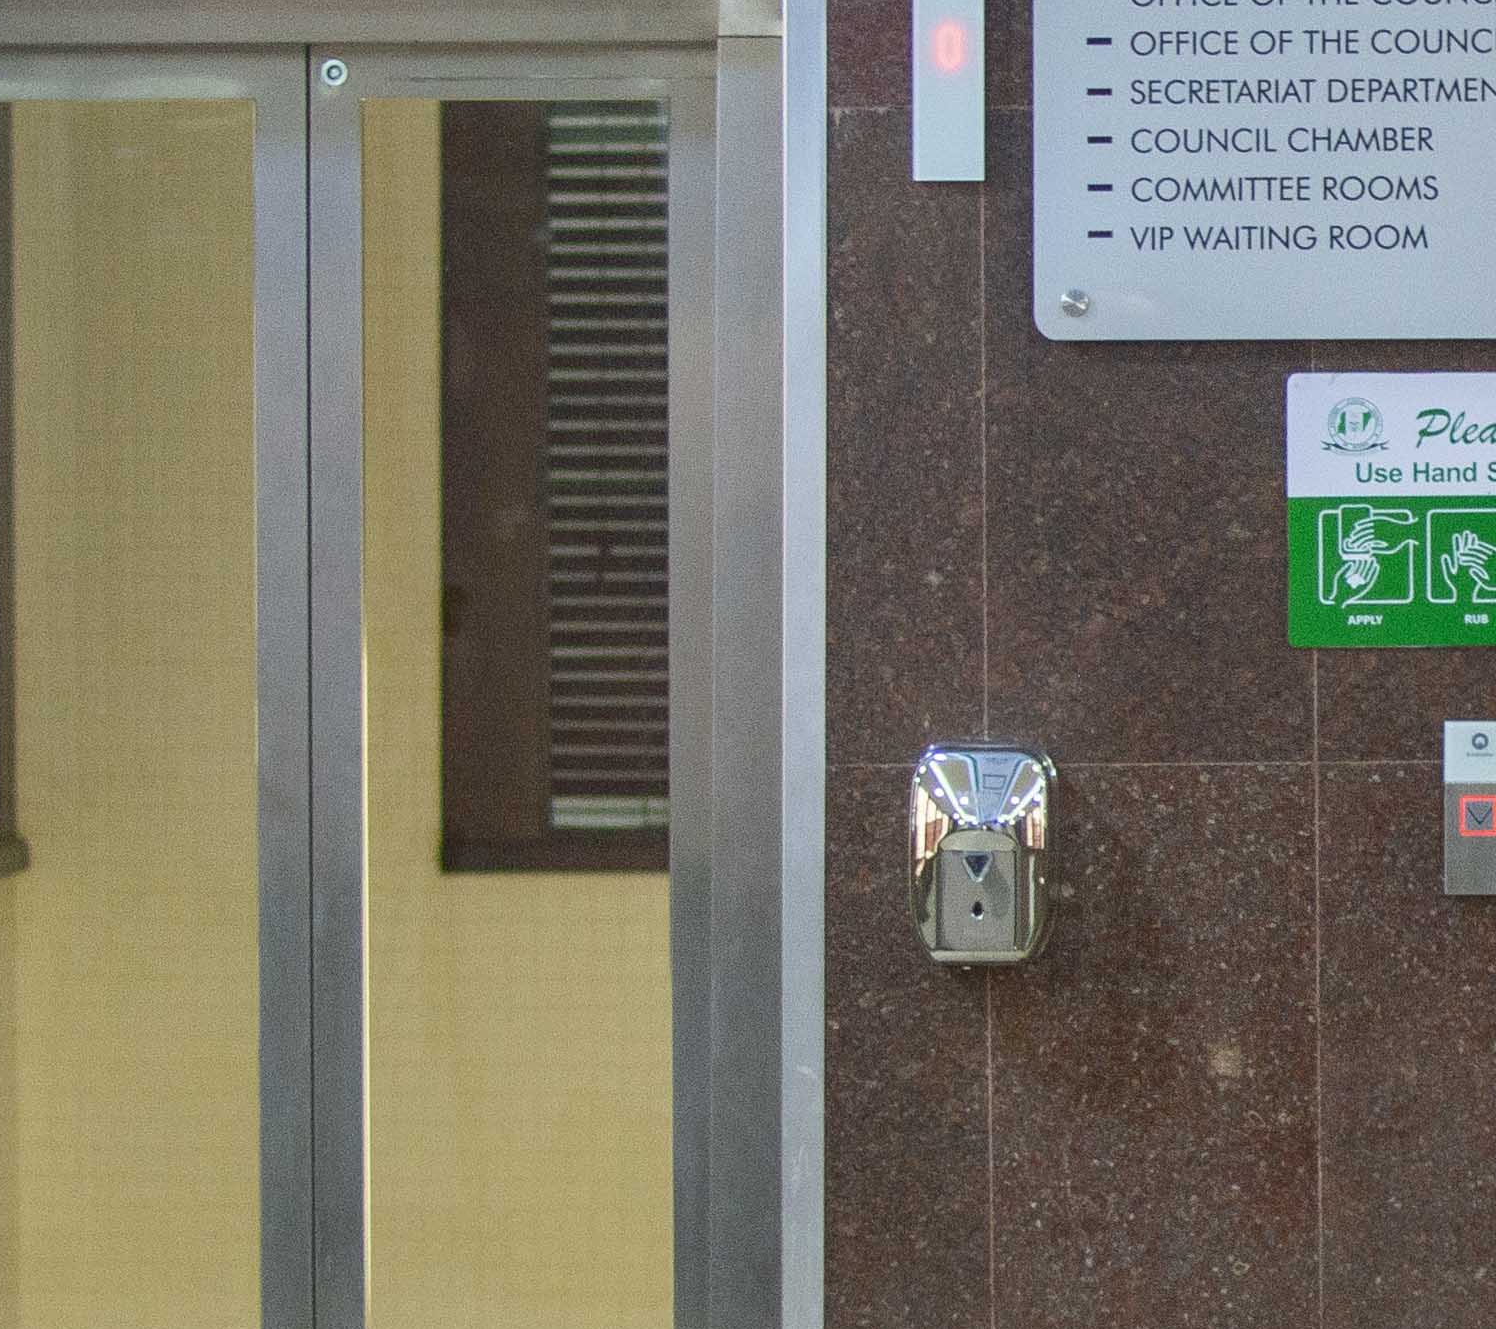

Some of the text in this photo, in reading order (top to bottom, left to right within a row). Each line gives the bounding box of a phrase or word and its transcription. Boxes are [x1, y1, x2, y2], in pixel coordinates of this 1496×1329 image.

[1130, 30, 1239, 58] OFFICE
[1250, 30, 1294, 57] OF
[1303, 30, 1360, 56] THE
[1131, 79, 1318, 106] SECRETARIAT
[1131, 127, 1435, 155] COUNCIL CHAMBER
[1131, 175, 1440, 204] COMMITTEE ROOMS
[1130, 225, 1430, 252] VIP WAITING ROOM
[1355, 462, 1403, 484] Use
[1412, 461, 1478, 484] Hand
[1347, 614, 1384, 626] APPLY
[1464, 613, 1490, 625] RUB
